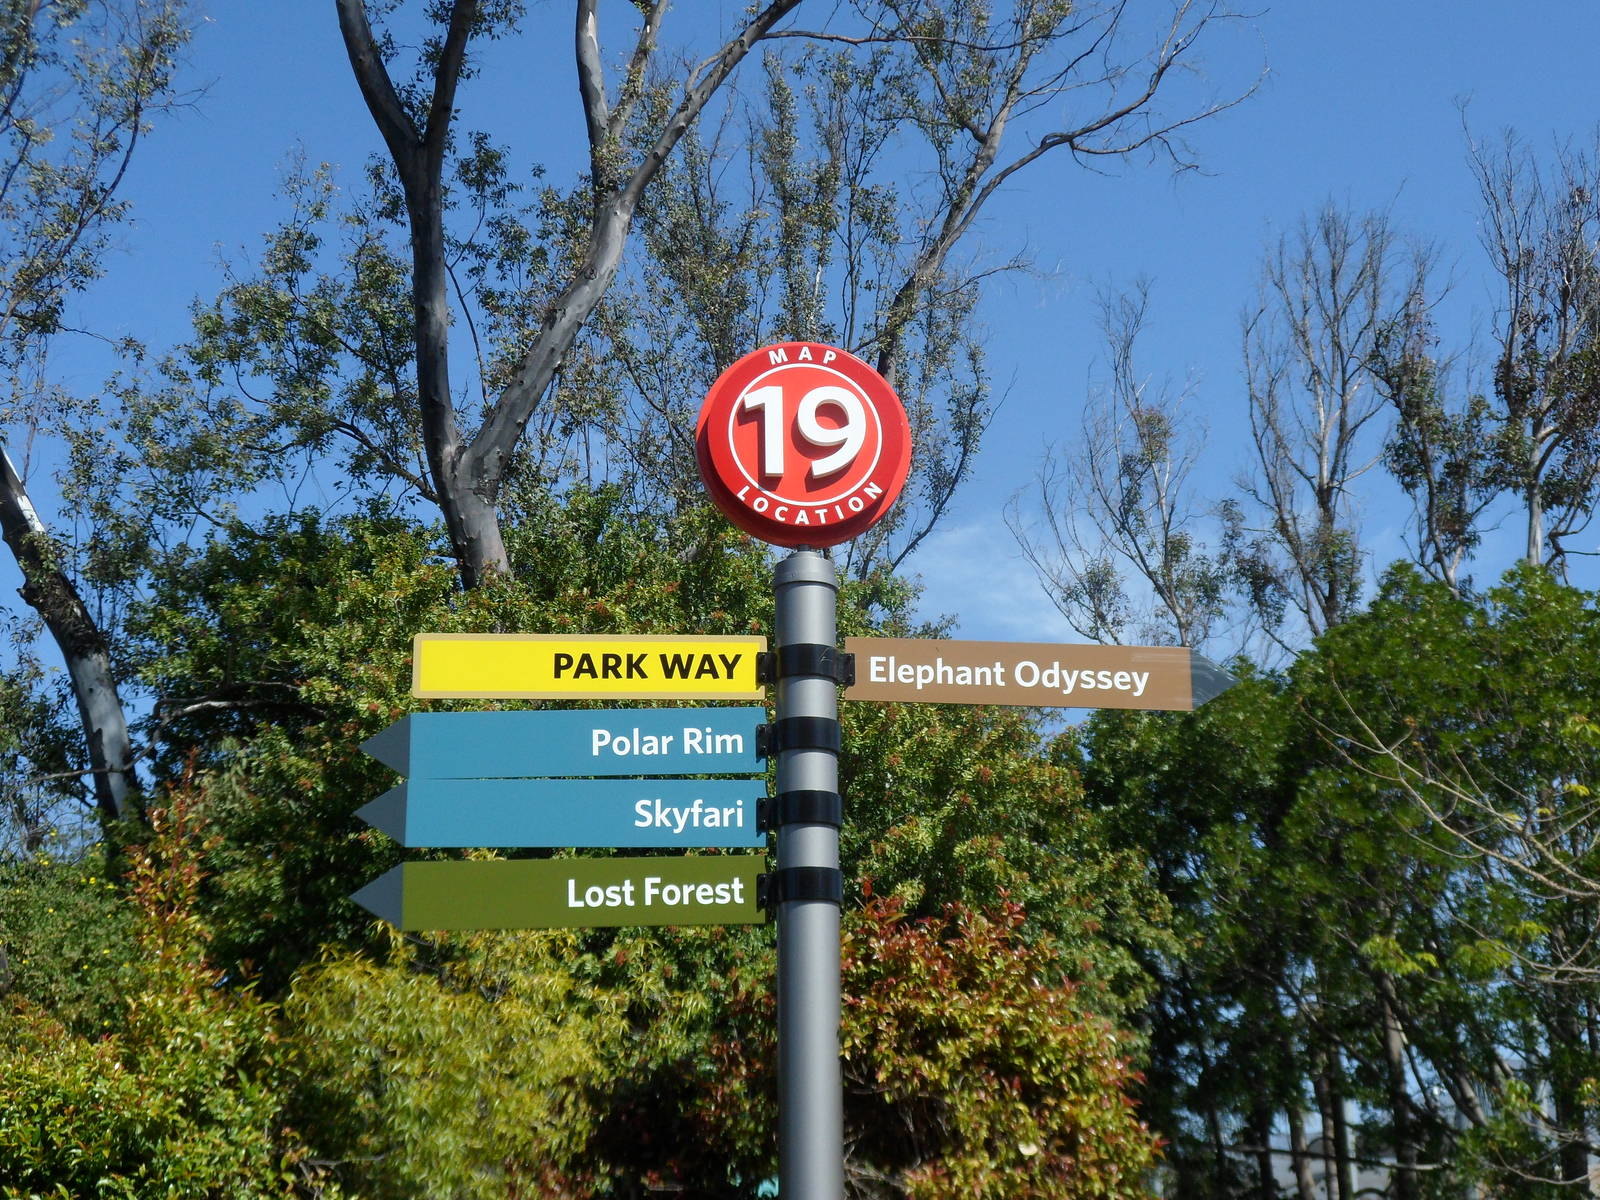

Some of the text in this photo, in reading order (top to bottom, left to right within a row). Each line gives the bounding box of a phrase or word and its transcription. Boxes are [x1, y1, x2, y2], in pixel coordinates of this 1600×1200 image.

[768, 346, 837, 365] MAP
[744, 386, 866, 478] 19
[736, 481, 884, 525] LOCATION
[553, 652, 743, 680] PARK WAY
[869, 656, 1149, 696] Elephant Odyssey
[592, 727, 744, 756] Polar Rim
[634, 800, 744, 834] Skyfari
[568, 876, 744, 908] Lost Forest
